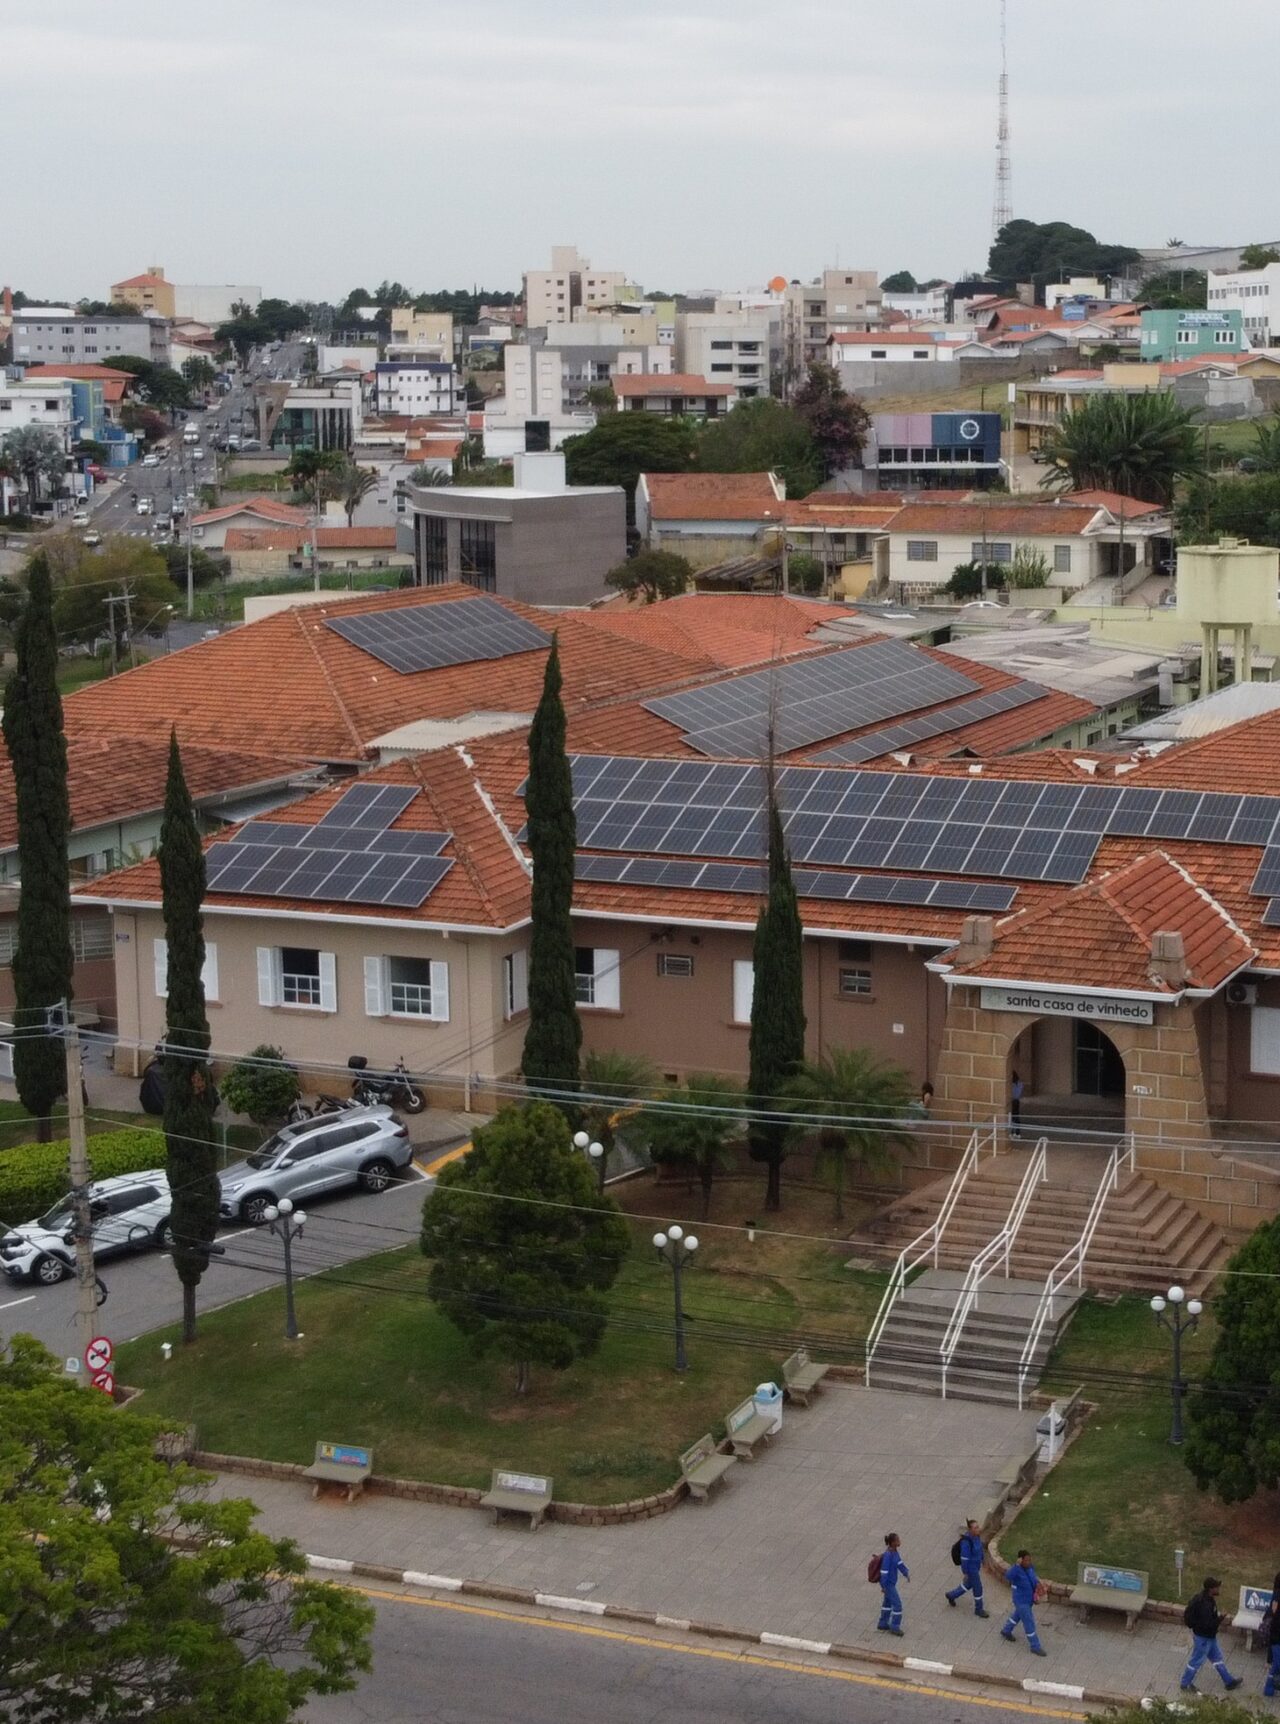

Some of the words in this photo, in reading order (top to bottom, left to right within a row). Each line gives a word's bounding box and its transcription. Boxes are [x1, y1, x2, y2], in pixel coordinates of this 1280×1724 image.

[1006, 995, 1041, 1009] santa
[1043, 999, 1074, 1012] casa
[1077, 1000, 1095, 1014] de
[1097, 1002, 1149, 1019] vinhedo
